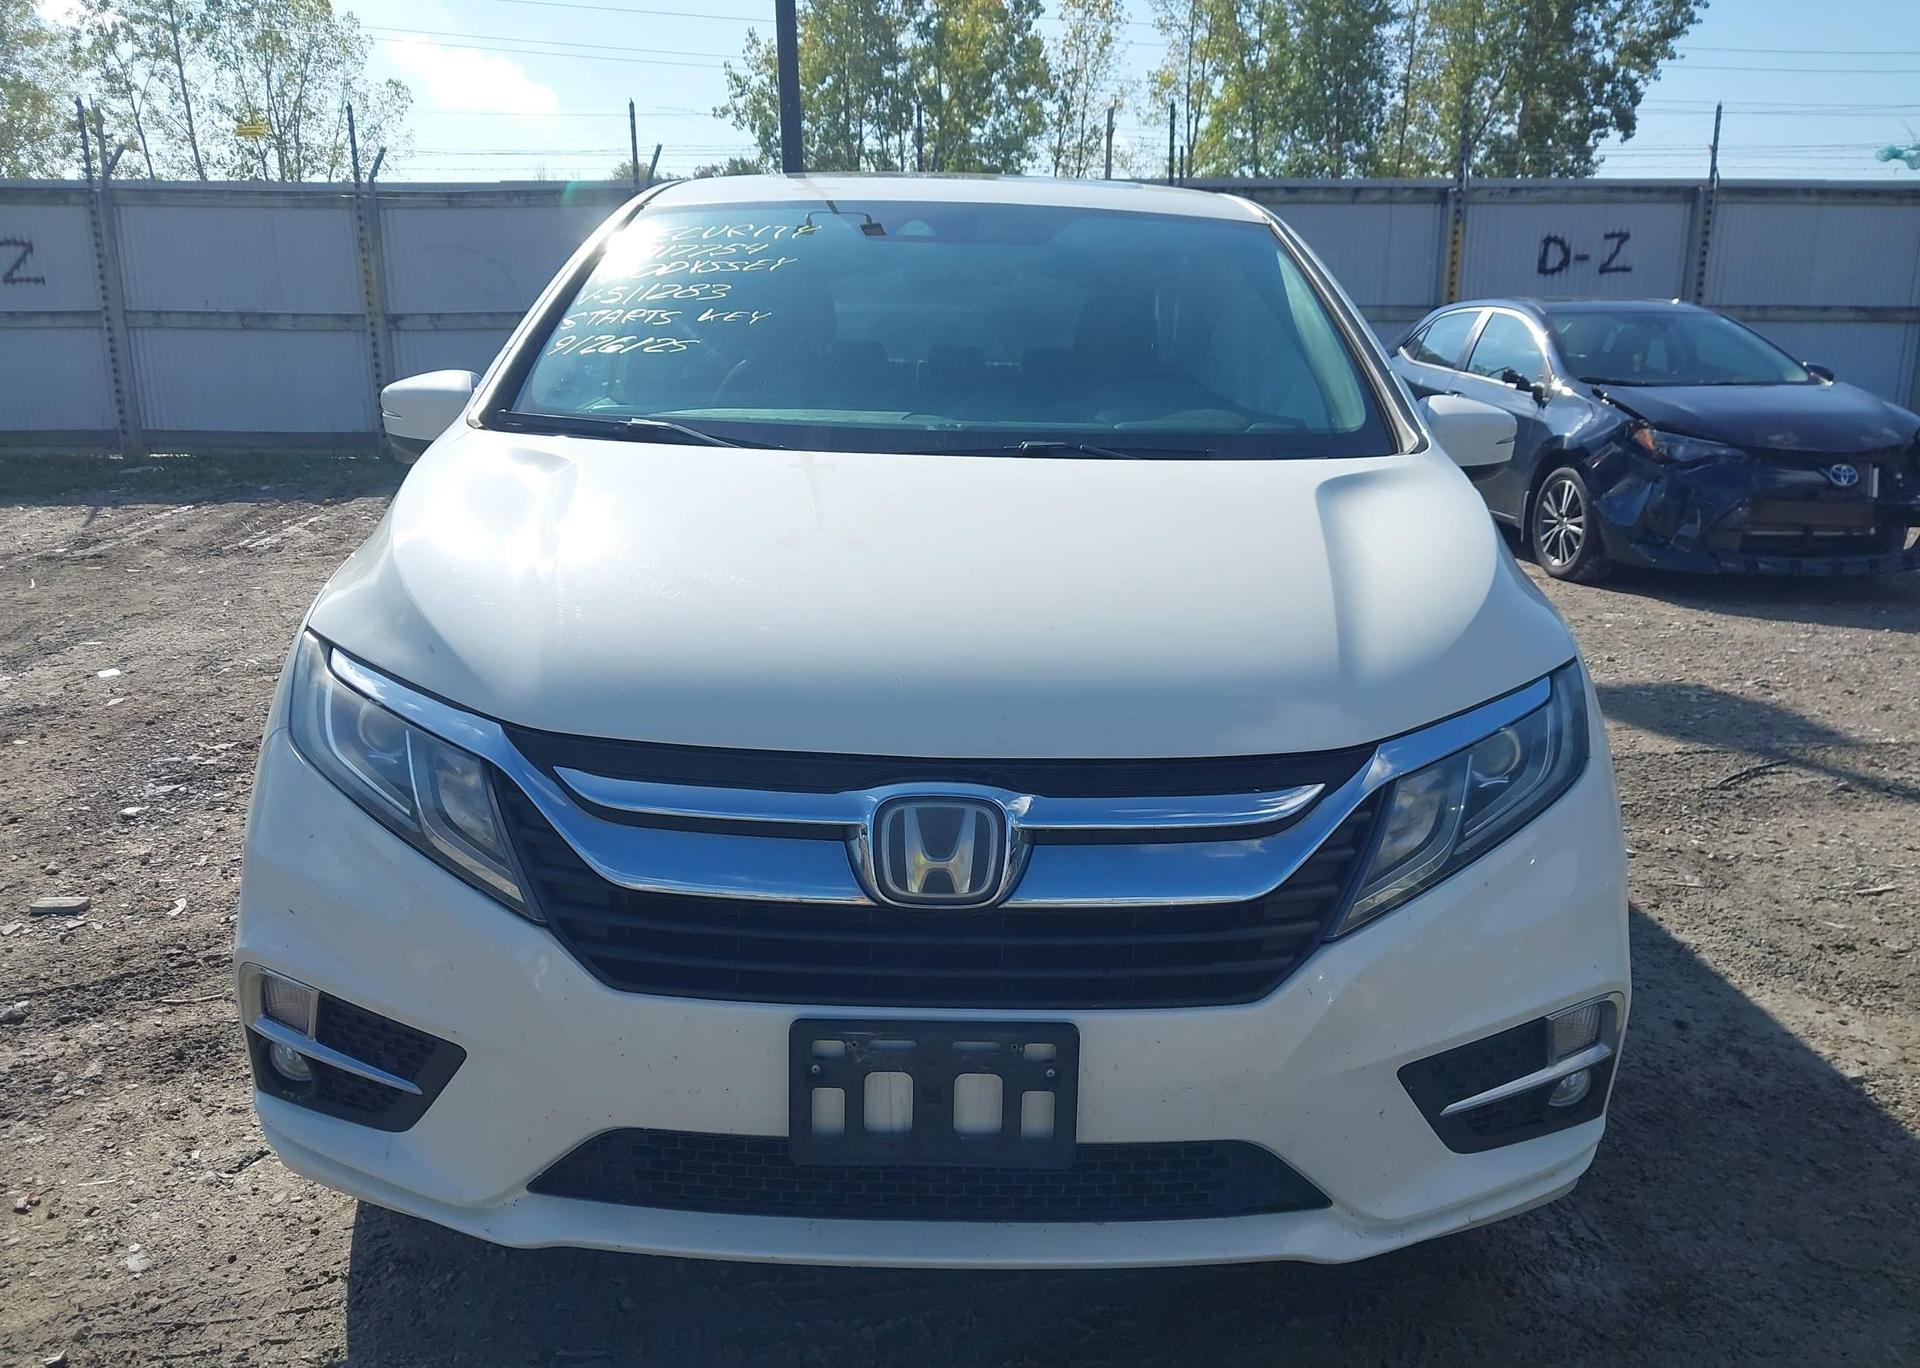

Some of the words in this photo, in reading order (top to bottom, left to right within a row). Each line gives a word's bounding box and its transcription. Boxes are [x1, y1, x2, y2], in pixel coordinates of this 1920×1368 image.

[560, 308, 683, 331] STARTS
[696, 307, 773, 326] KEY
[547, 334, 701, 357] 9/26/25
